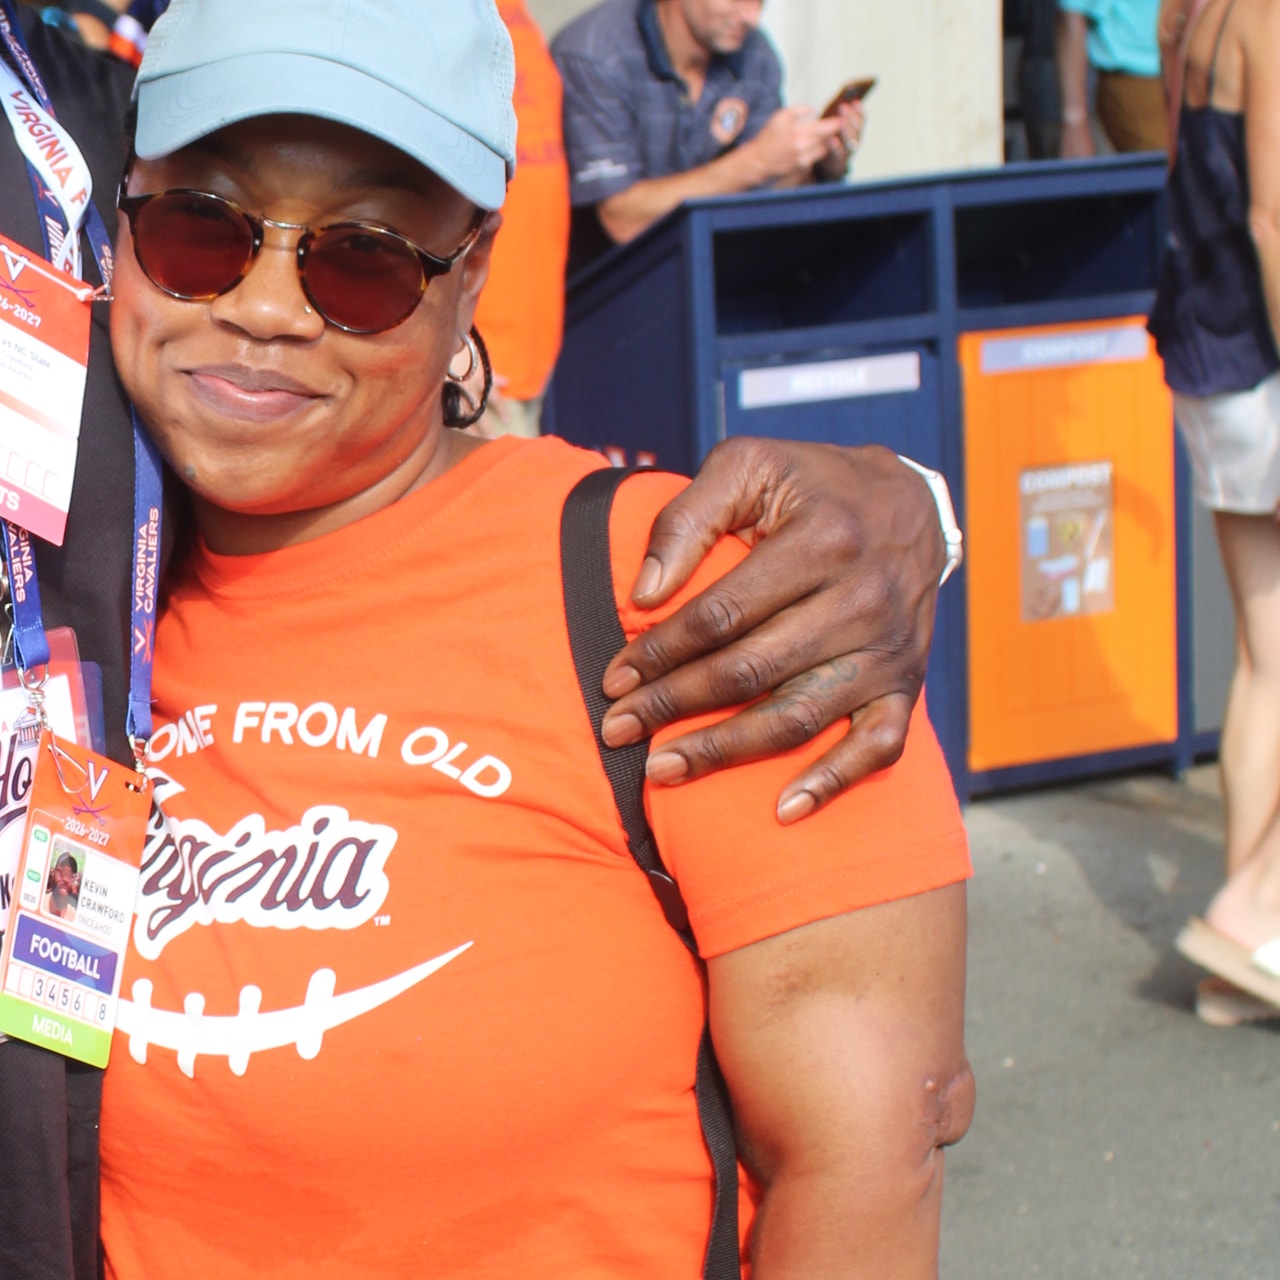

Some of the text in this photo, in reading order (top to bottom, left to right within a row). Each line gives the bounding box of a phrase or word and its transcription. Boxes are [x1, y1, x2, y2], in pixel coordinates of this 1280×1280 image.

[9, 89, 74, 188] VIRGINIA
[14, 343, 27, 357] NC
[30, 351, 51, 369] State
[19, 527, 34, 583] GINIA
[135, 523, 149, 612] VIRGINIA
[144, 507, 160, 614] CAVALIERS
[1, 721, 9, 733] A
[233, 701, 388, 758] FROM
[401, 726, 512, 798] OLD
[64, 817, 110, 846] 2026-2027
[84, 879, 109, 898] KEVIN
[81, 897, 125, 923] CRAWFORD
[30, 934, 101, 980] FOOTBALL
[99, 1003, 107, 1021] 8
[32, 1014, 73, 1046] MEDIA
